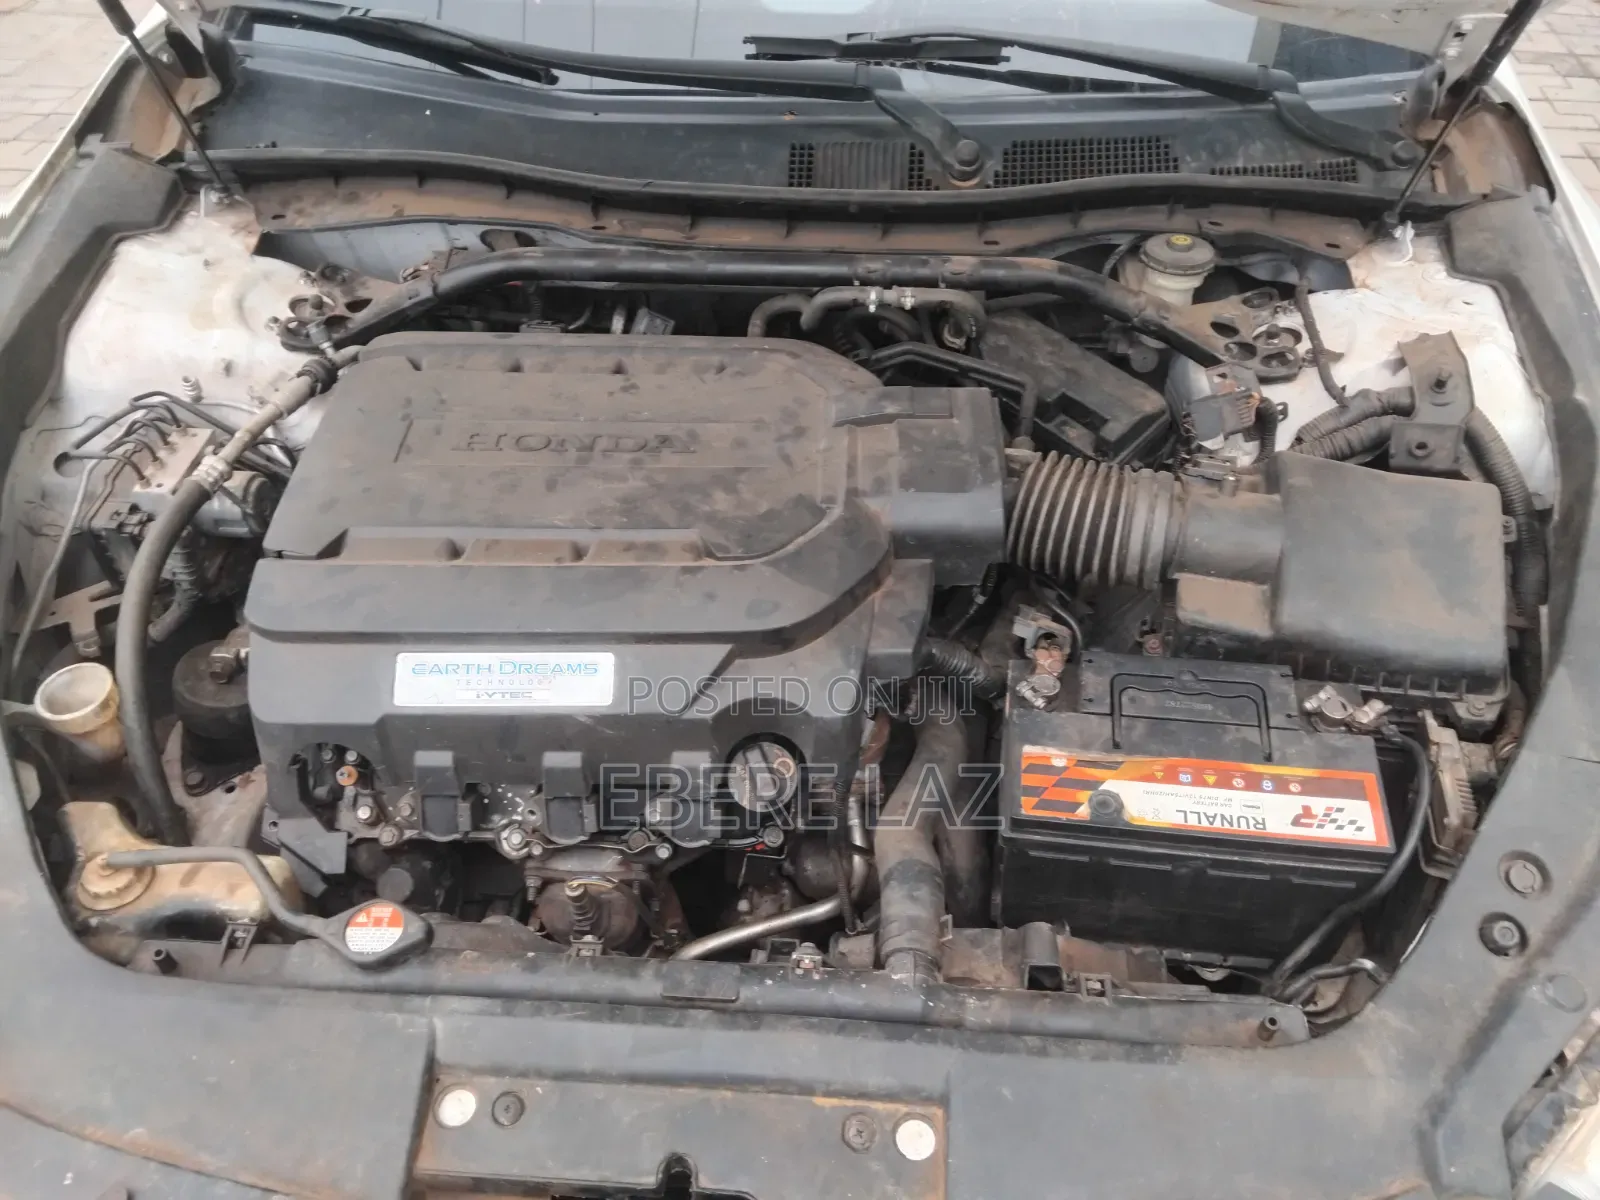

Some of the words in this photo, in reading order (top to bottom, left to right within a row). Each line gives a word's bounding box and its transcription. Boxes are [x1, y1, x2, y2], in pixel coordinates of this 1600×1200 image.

[450, 432, 698, 454] HONDA
[411, 663, 492, 675] EARTH
[499, 661, 598, 676] DREAMS
[476, 691, 533, 699] i-VTEC
[1175, 809, 1267, 831] RUNALL
